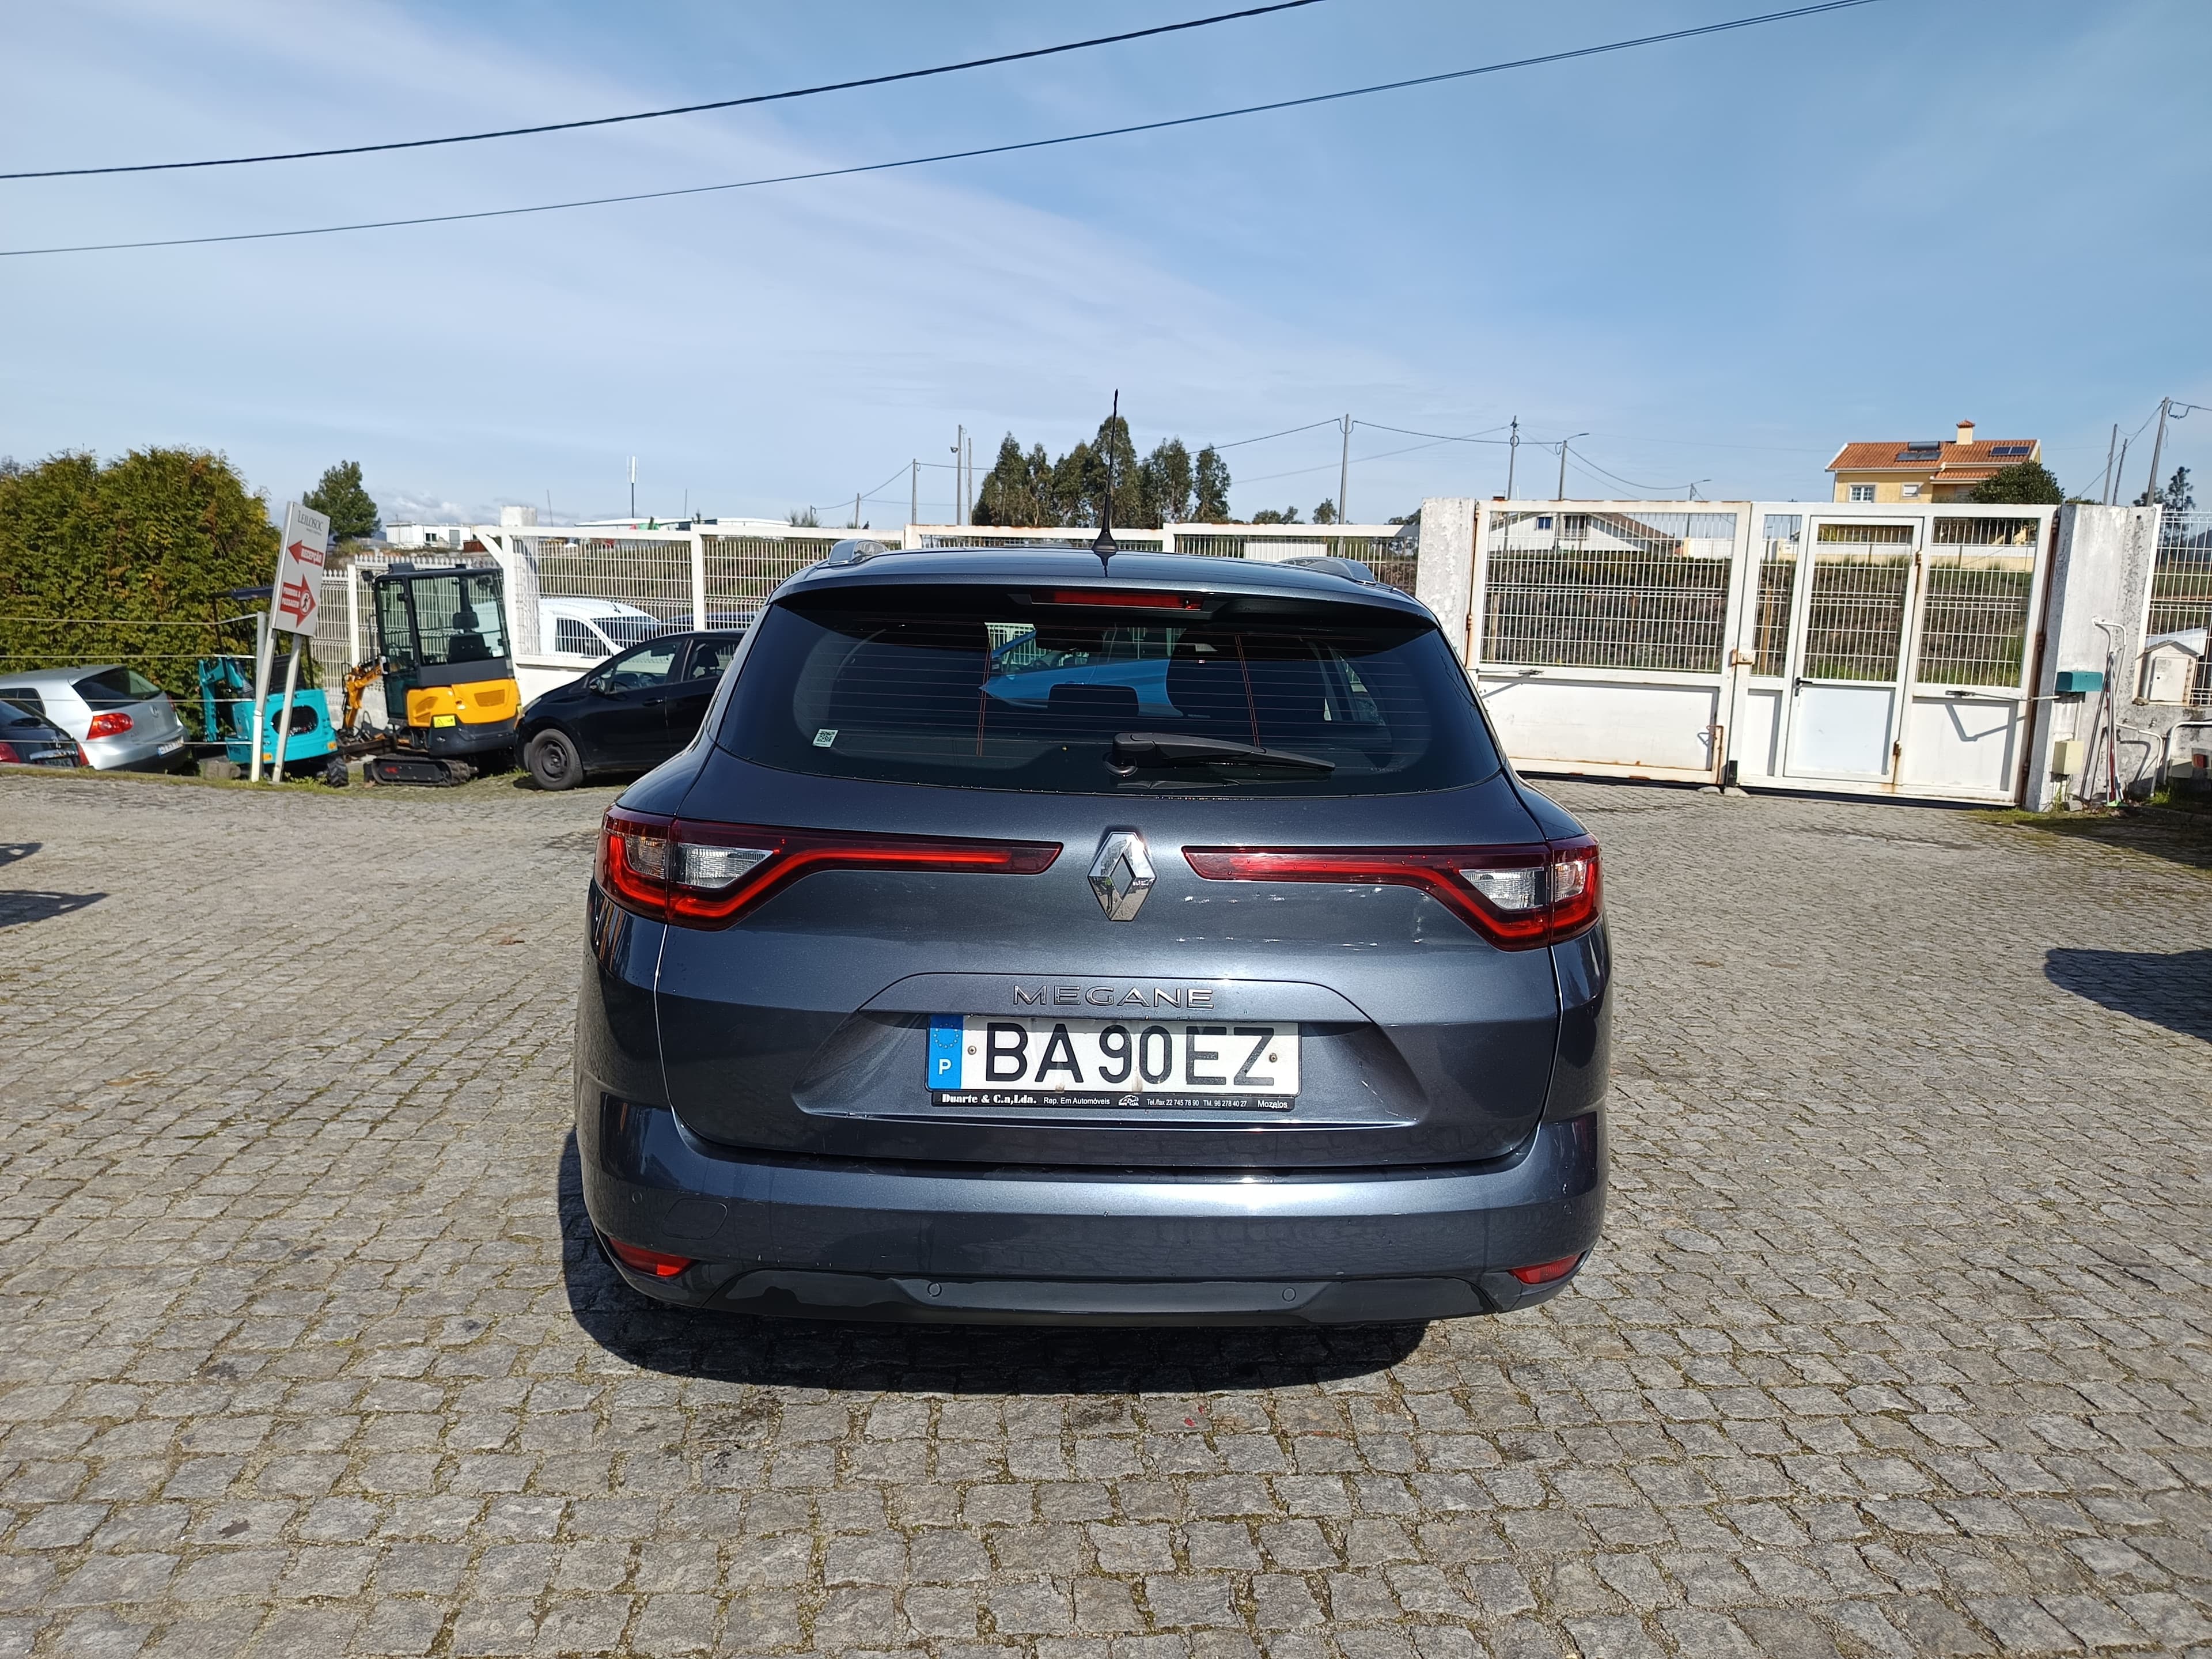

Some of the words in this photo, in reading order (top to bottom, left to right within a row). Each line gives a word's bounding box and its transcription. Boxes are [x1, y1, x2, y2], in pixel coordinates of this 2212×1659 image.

[297, 510, 324, 532] LEILOSOC
[1013, 986, 1214, 1009] MEGANE
[986, 1022, 1084, 1084] BA
[938, 1059, 952, 1075] P
[942, 1093, 978, 1103] Duarte
[980, 1094, 990, 1103] &
[1043, 1097, 1059, 1105] Rep.
